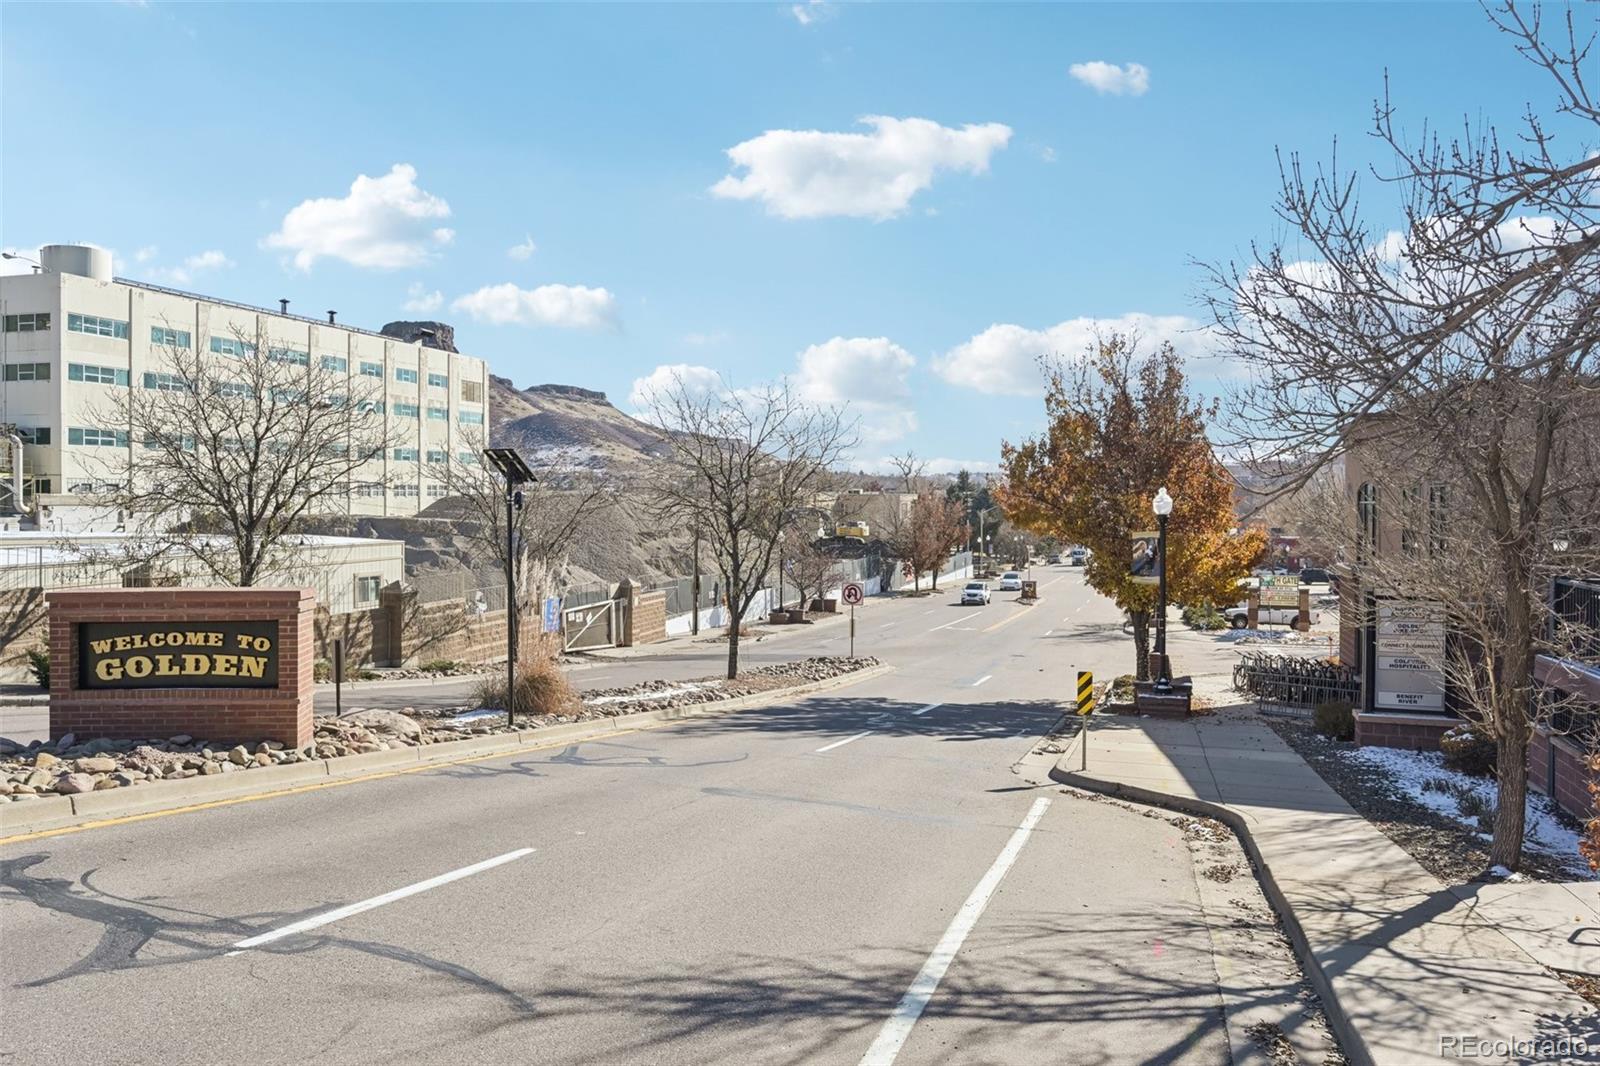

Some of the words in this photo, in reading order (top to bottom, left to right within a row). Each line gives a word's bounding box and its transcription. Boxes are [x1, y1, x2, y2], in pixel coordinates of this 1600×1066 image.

[89, 631, 224, 655] WELCOME
[236, 634, 272, 652] TO
[95, 653, 268, 681] GOLDEN
